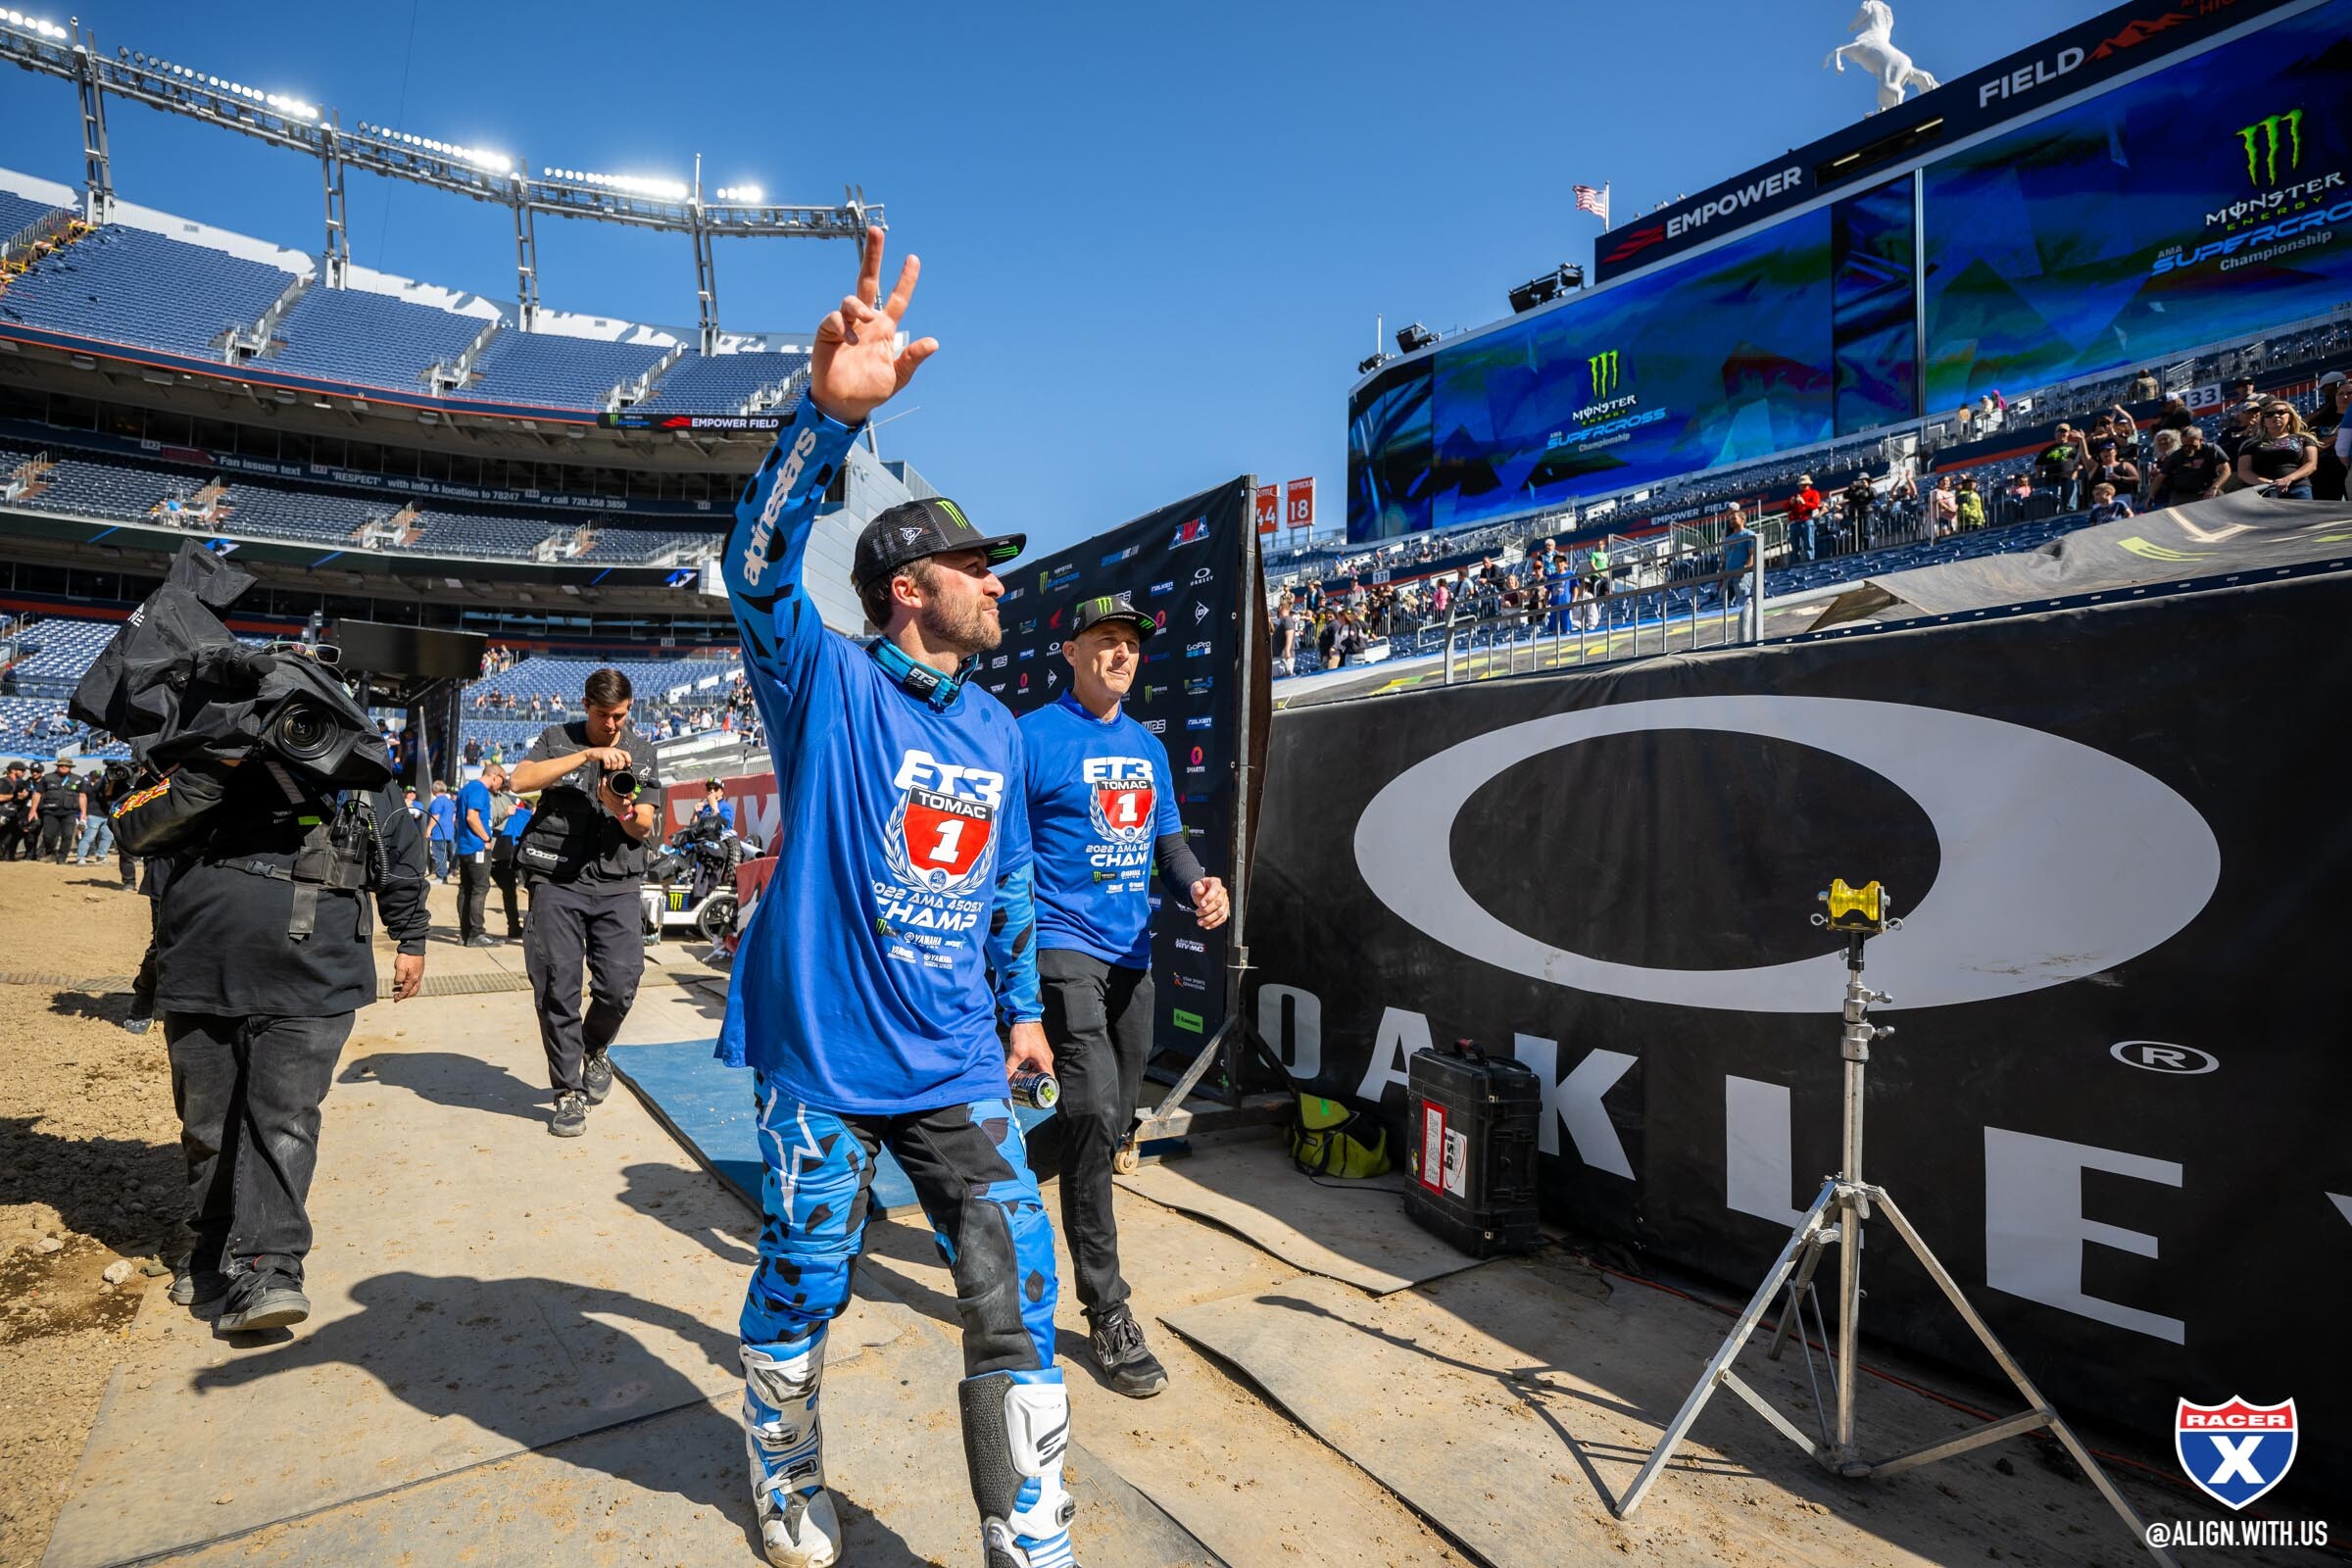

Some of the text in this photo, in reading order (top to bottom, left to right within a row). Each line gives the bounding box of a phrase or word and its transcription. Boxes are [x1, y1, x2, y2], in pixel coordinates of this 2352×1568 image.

[1667, 47, 2084, 239] EMPOWER FIELD
[2206, 172, 2345, 226] MONSTER
[2226, 195, 2323, 231] ENERGY
[2158, 244, 2182, 259] AMA
[2220, 230, 2332, 271] Championship
[1572, 394, 1638, 421] MONSTER
[691, 417, 779, 429] EMPOWER FIELD
[1545, 407, 1667, 451] SUPERCROSS
[1578, 432, 1631, 452] Championship
[220, 456, 240, 467] Fan
[242, 459, 277, 473] issues
[280, 466, 301, 476] text
[387, 479, 409, 489] with
[412, 482, 429, 492] info
[441, 485, 479, 498] location
[481, 488, 491, 499] to
[492, 491, 519, 502] 78247
[553, 496, 568, 505] call
[607, 500, 627, 509] 3850
[1291, 499, 1309, 520] 18
[1650, 509, 1699, 526] EMPOWER
[1374, 572, 1389, 583] 131
[1186, 641, 1211, 652] GoPro
[909, 667, 940, 687] ET3
[894, 749, 1004, 811] ET3
[1083, 757, 1154, 784] ET3
[1102, 780, 1148, 790] TOMAC
[919, 791, 987, 820] TOMAC
[1116, 792, 1139, 822] 1
[928, 819, 965, 864] 1
[1085, 844, 1115, 854] 2022
[1115, 843, 1138, 854] AMA
[907, 893, 944, 908] AMA
[947, 900, 985, 912] 450SX
